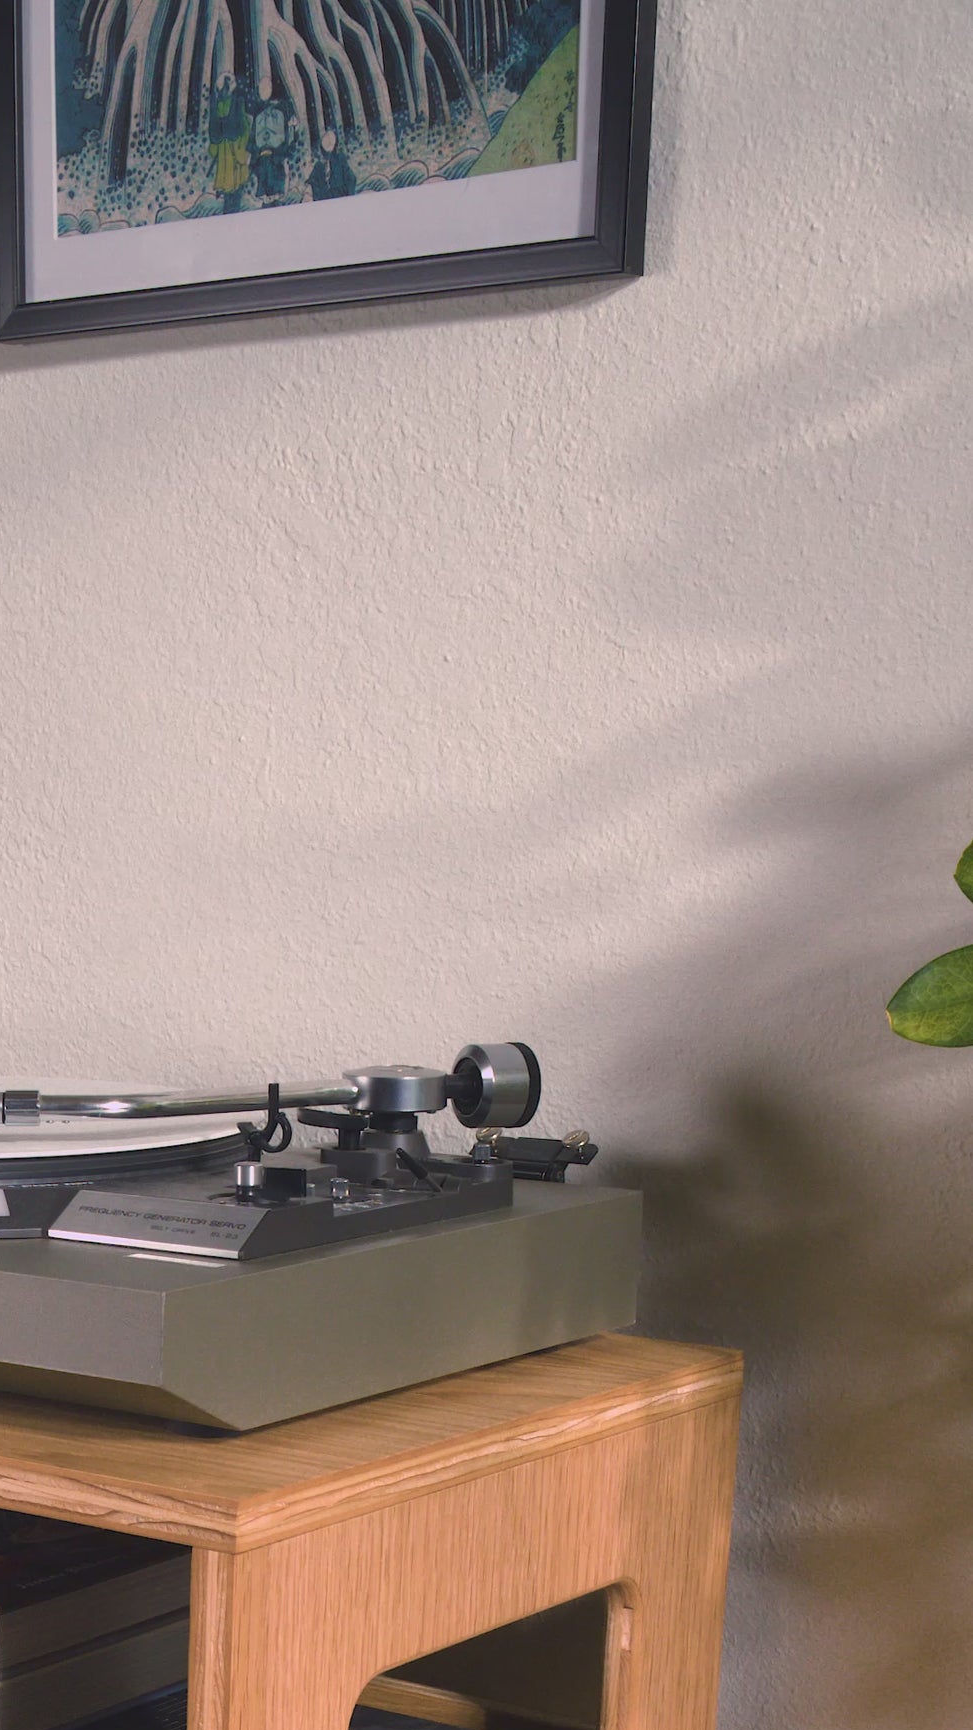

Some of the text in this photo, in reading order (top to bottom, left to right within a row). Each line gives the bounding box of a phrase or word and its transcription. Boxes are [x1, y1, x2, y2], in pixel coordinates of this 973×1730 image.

[78, 1205, 247, 1231] FREQUENCY GENERATOR SERVO
